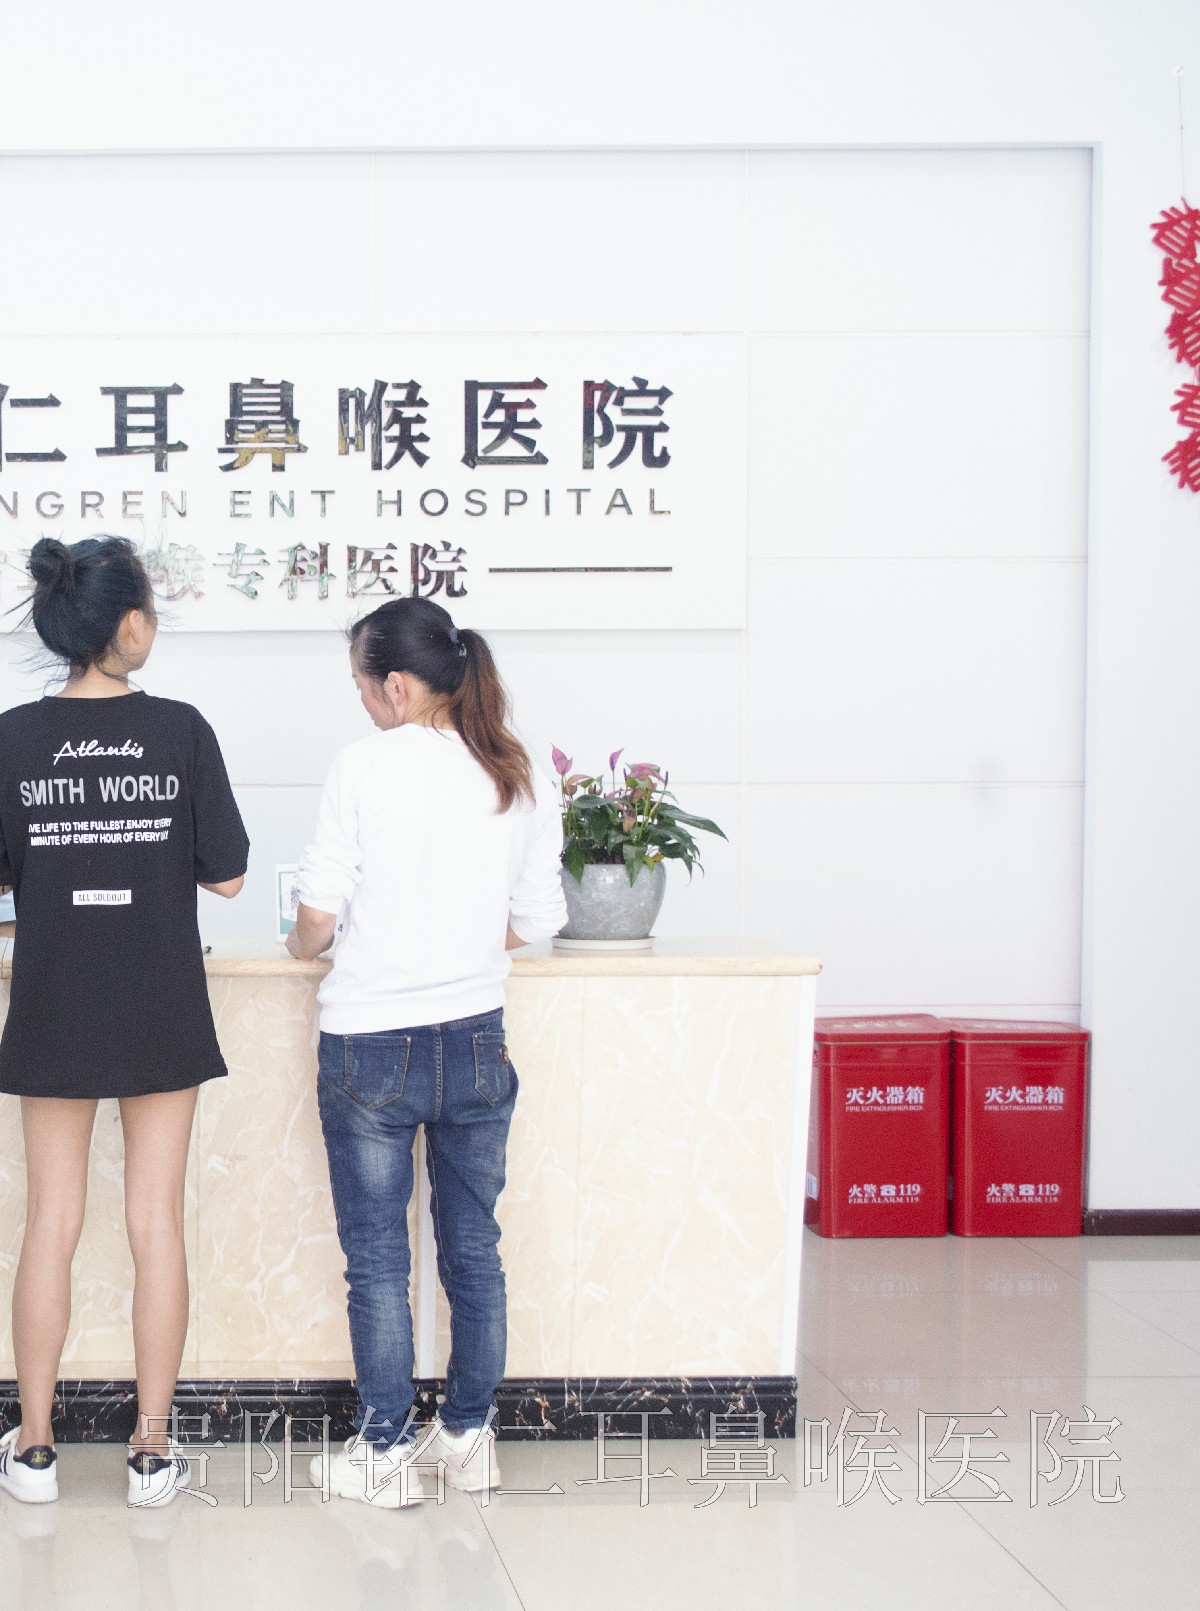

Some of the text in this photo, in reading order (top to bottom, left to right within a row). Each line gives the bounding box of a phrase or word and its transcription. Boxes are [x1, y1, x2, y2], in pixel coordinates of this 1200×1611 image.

[230, 489, 336, 519] ENT
[377, 488, 672, 518] HOSPITAL
[53, 739, 145, 766] Atlantis
[19, 774, 180, 807] SMITH WORLD
[41, 822, 59, 833] LIFE
[59, 821, 72, 832] TO
[72, 821, 89, 832] THE
[153, 818, 172, 829] EERY
[30, 835, 60, 846] MINUTE
[61, 834, 72, 845] OF
[73, 833, 99, 844] EVERY
[99, 832, 123, 844] HOUR
[123, 831, 134, 842] OF
[134, 831, 160, 842] EVERY
[845, 1086, 925, 1104] 灭火器箱
[984, 1086, 1065, 1104] 灭火器箱
[848, 1183, 921, 1197] 火警 119
[1037, 1183, 1060, 1196] 119
